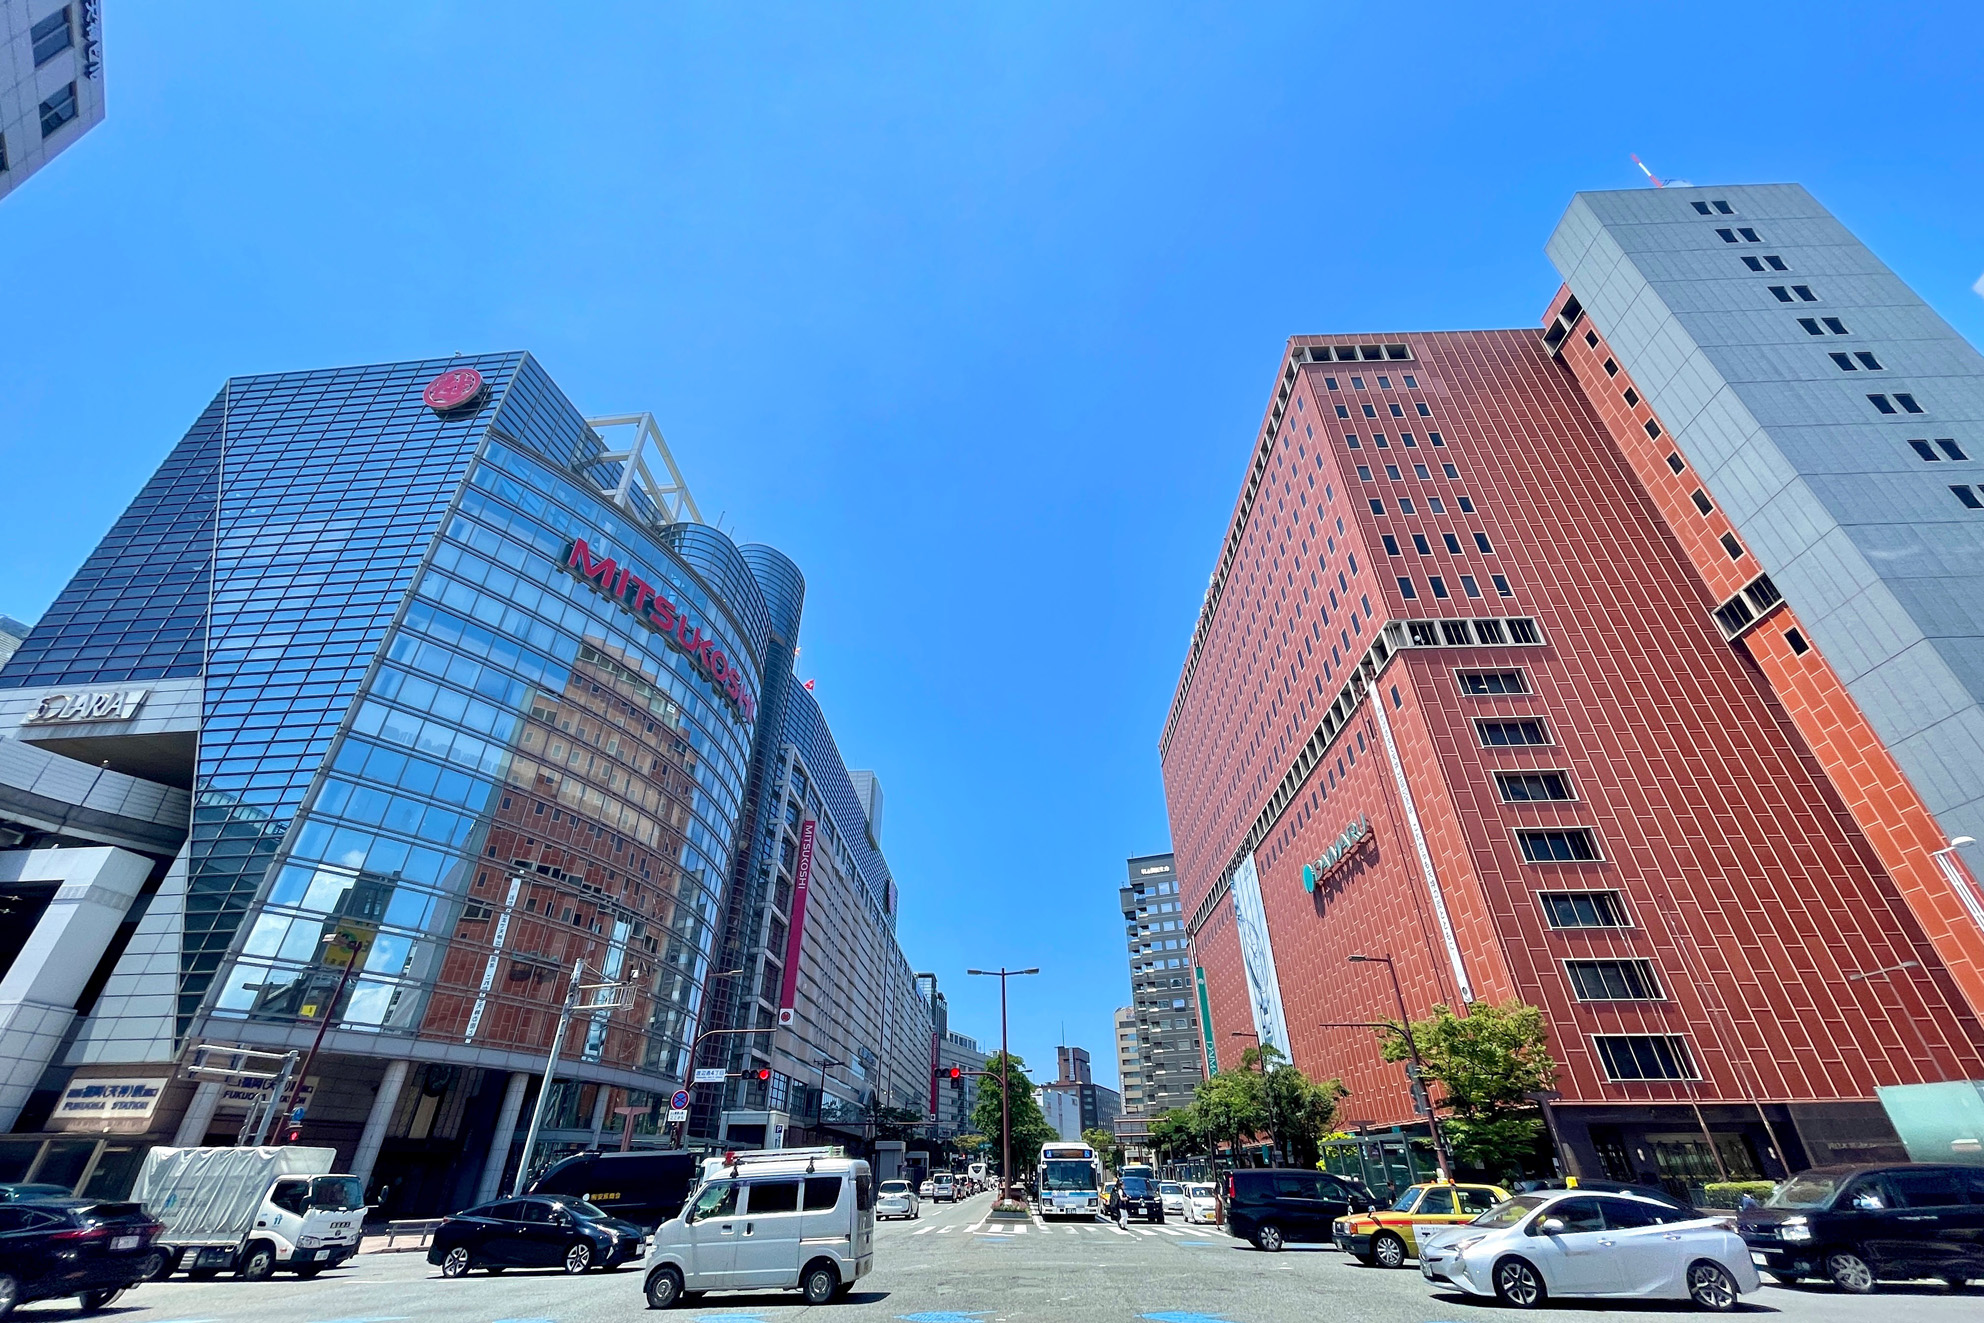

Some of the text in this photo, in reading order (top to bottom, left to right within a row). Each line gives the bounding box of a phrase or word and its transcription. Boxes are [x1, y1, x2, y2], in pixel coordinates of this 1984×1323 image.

[568, 537, 756, 723] MITSUKOSHI
[28, 691, 127, 719] SOLARIA
[797, 824, 814, 890] MITSUKOSHI
[1206, 1041, 1218, 1077] DAIMA
[223, 1090, 266, 1102] FUKUO
